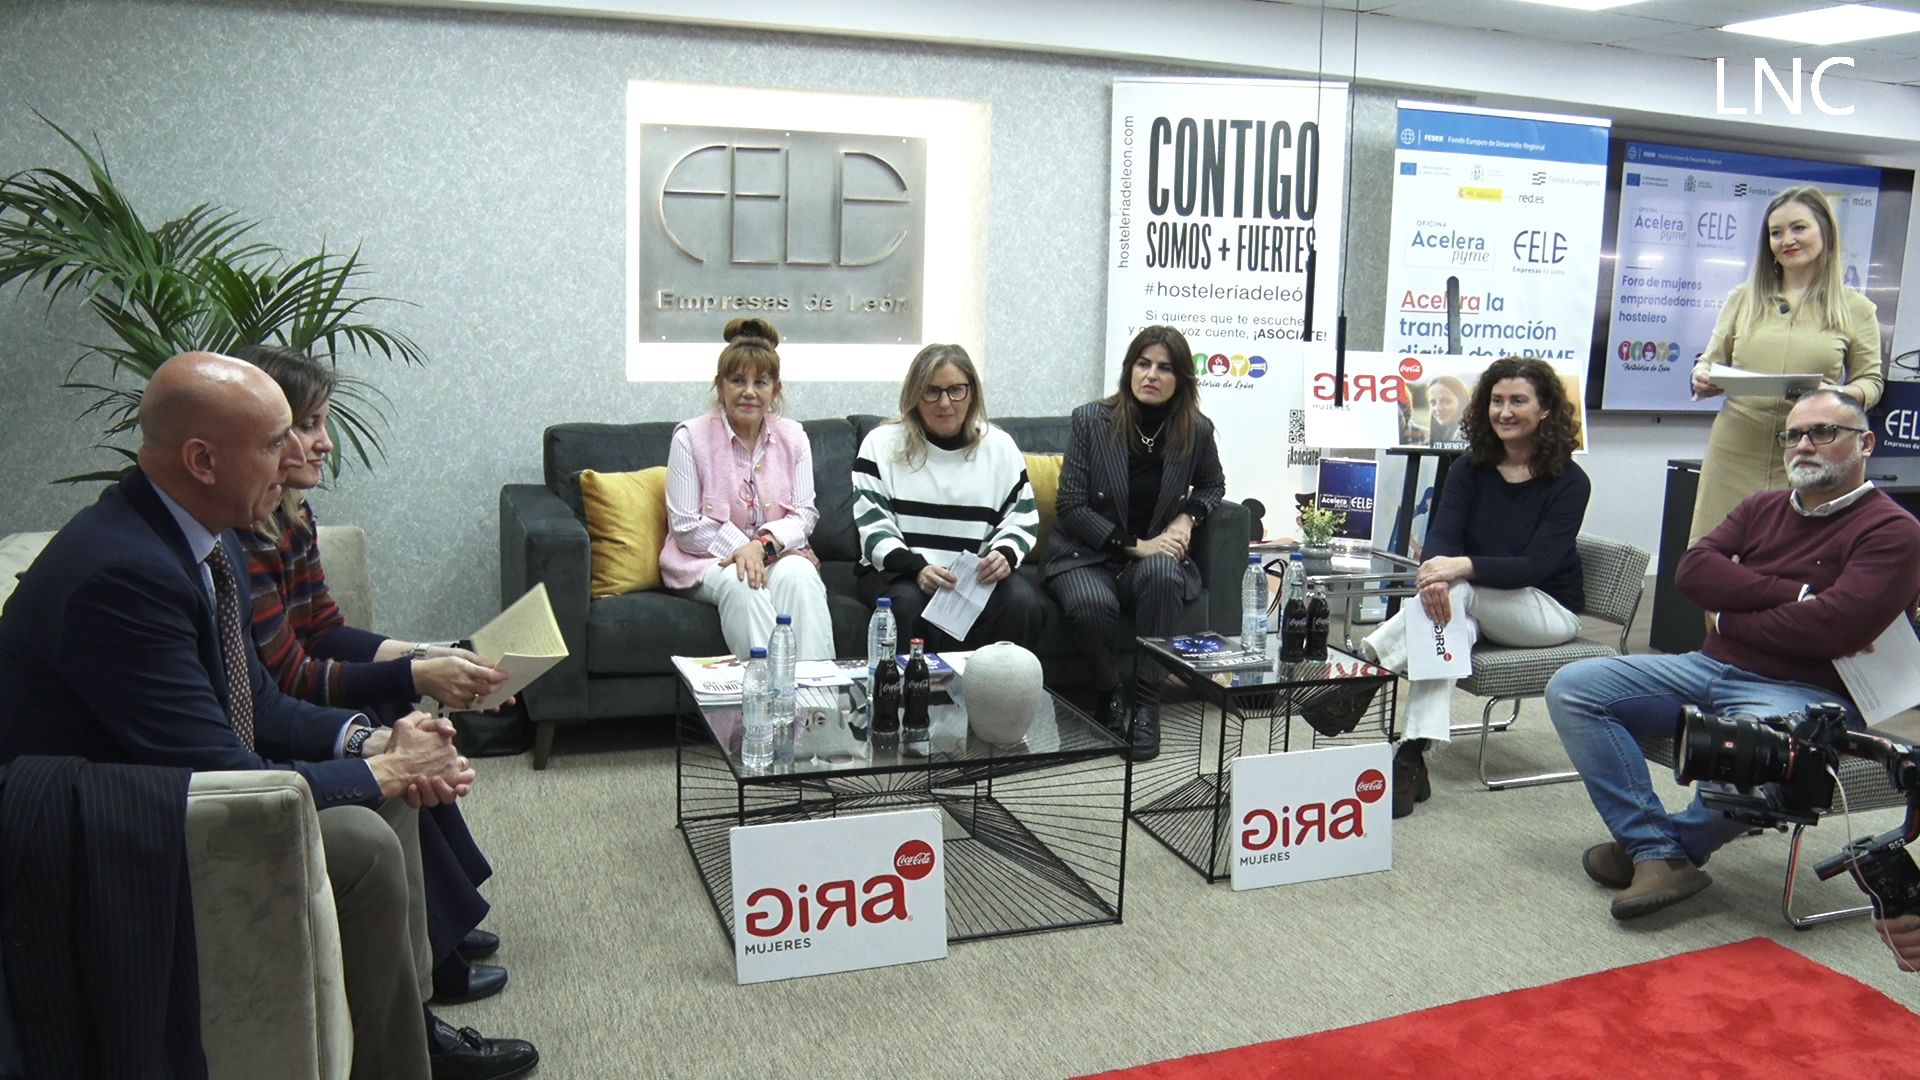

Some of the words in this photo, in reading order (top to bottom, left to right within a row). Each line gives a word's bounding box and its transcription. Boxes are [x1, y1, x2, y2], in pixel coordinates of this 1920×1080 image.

[1148, 116, 1319, 221] CONTIGO
[1118, 115, 1134, 268] hosteleriadeleon.com
[1518, 194, 1544, 204] red.es
[1416, 220, 1447, 228] OFICINA
[1634, 214, 1683, 231] Acelera
[1146, 221, 1212, 270] SOMOS
[1237, 224, 1316, 273] FUERTES
[1411, 230, 1485, 250] Acelera
[1451, 249, 1490, 265] pyme
[1622, 275, 1645, 287] Foro
[1646, 276, 1659, 288] de
[1661, 278, 1702, 291] mujeres
[1144, 281, 1304, 303] #hosteleríadeleó
[1401, 290, 1481, 311] Acelra
[1486, 292, 1505, 311] la
[657, 289, 792, 313] Empresas
[804, 293, 835, 312] de
[848, 292, 911, 313] León
[1620, 294, 1701, 308] emprendedoras
[1145, 309, 1157, 321] Si
[1161, 312, 1206, 323] quieres
[1211, 314, 1233, 325] que
[1238, 315, 1248, 324] te
[1253, 316, 1304, 327] escuche
[1618, 311, 1667, 323] hostelero
[1128, 326, 1135, 336] y
[1181, 327, 1201, 337] voz
[1205, 328, 1249, 340] cuente,
[1399, 318, 1557, 341] transormación
[1239, 851, 1291, 866] MUJERES
[744, 937, 812, 956] MUJERES
